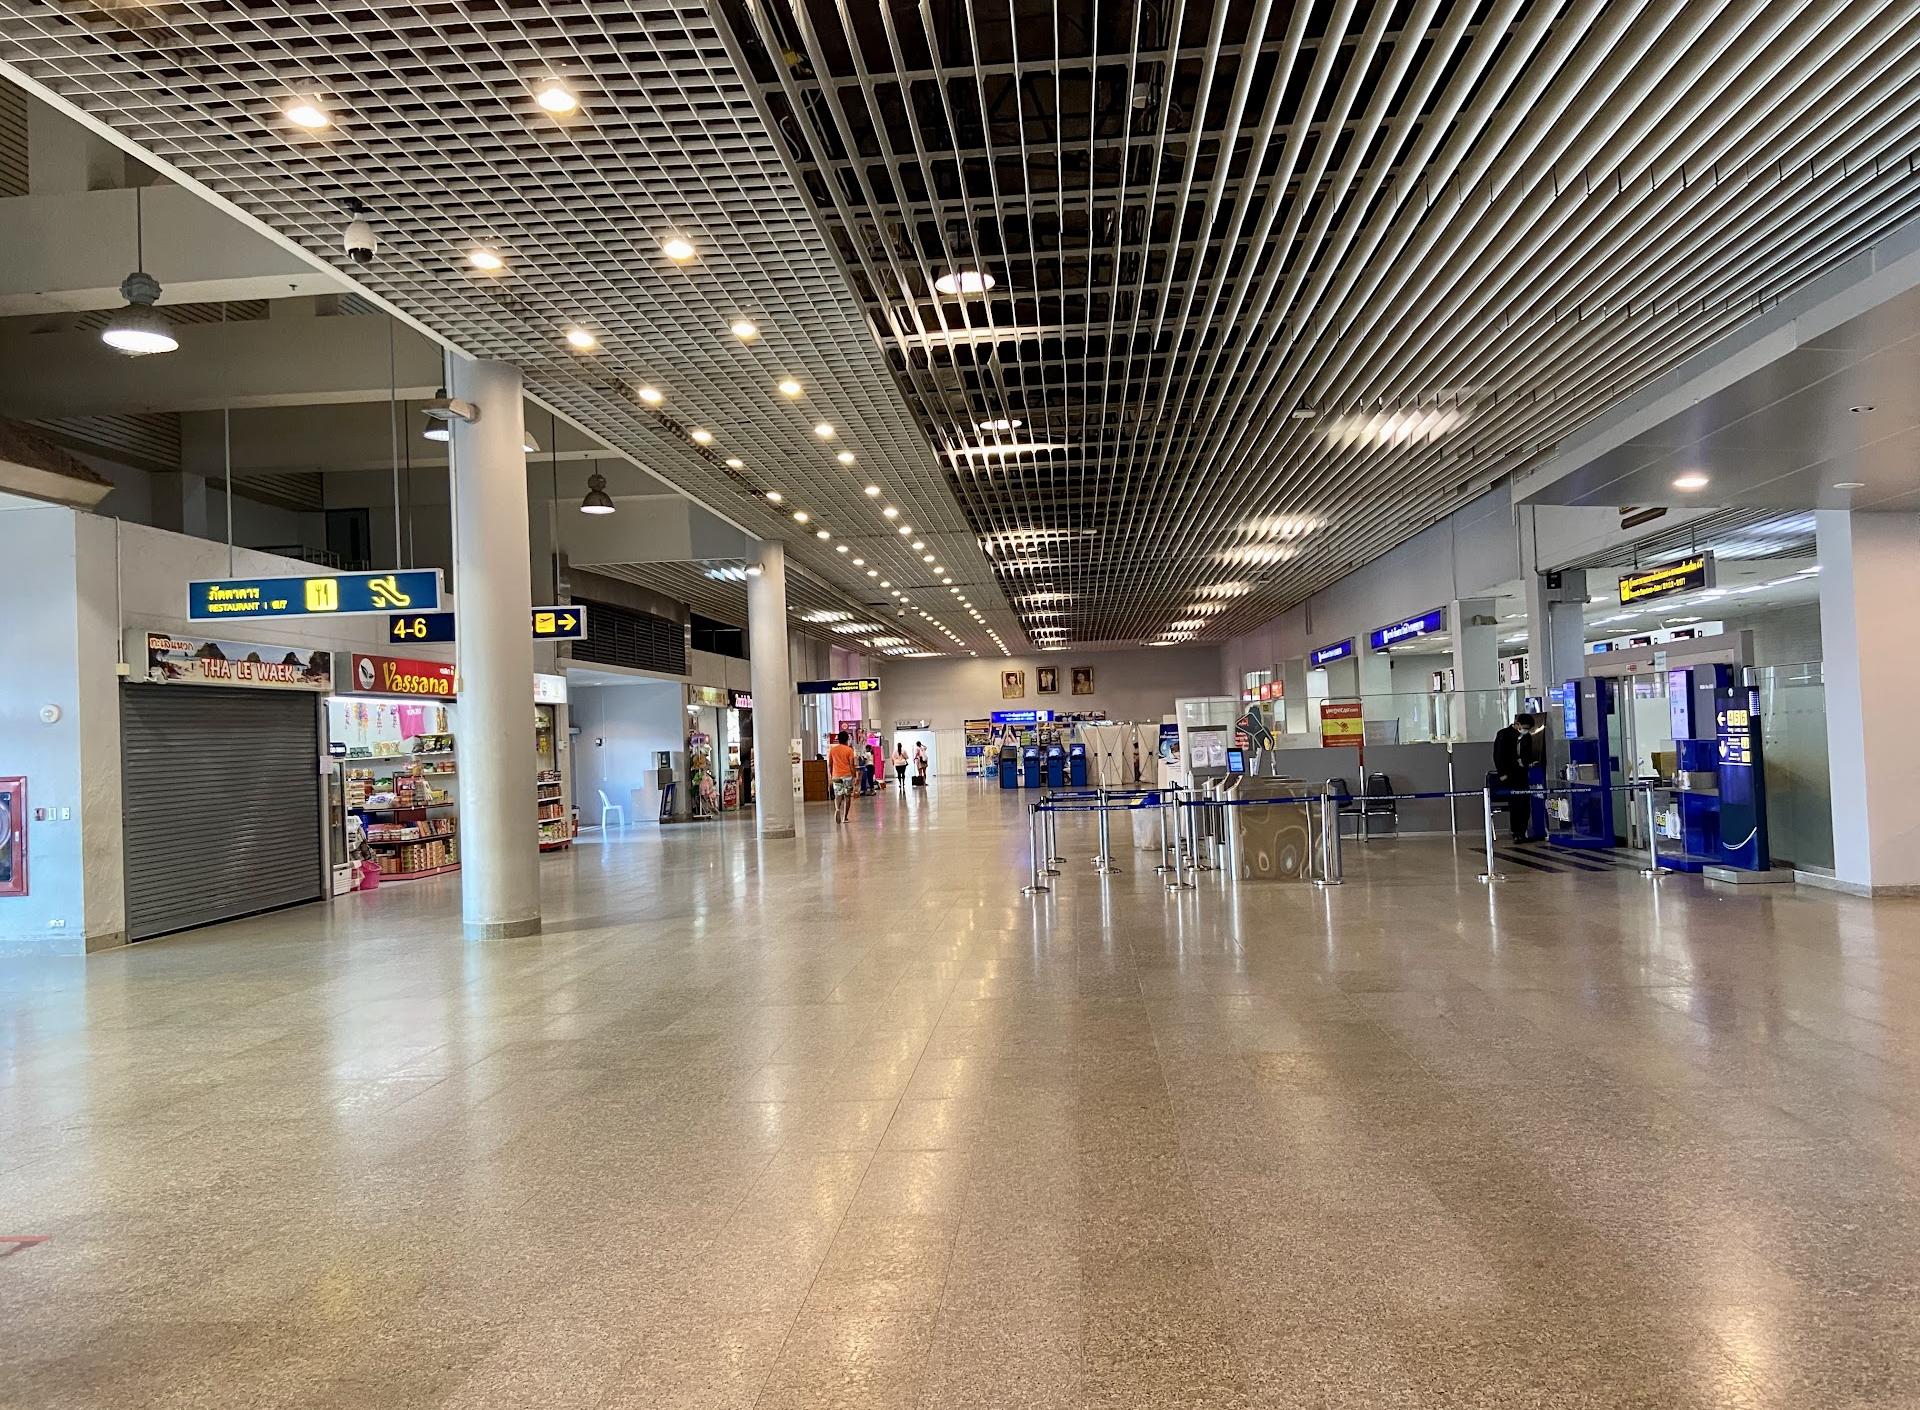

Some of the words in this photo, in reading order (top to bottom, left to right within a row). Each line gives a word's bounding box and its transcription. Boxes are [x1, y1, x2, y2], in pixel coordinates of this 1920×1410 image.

[208, 602, 260, 612] RESTAURANT
[394, 617, 427, 638] 4-6
[201, 659, 231, 678] THA
[237, 660, 252, 679] LE
[257, 662, 295, 682] WAEK
[382, 661, 449, 695] Vassana
